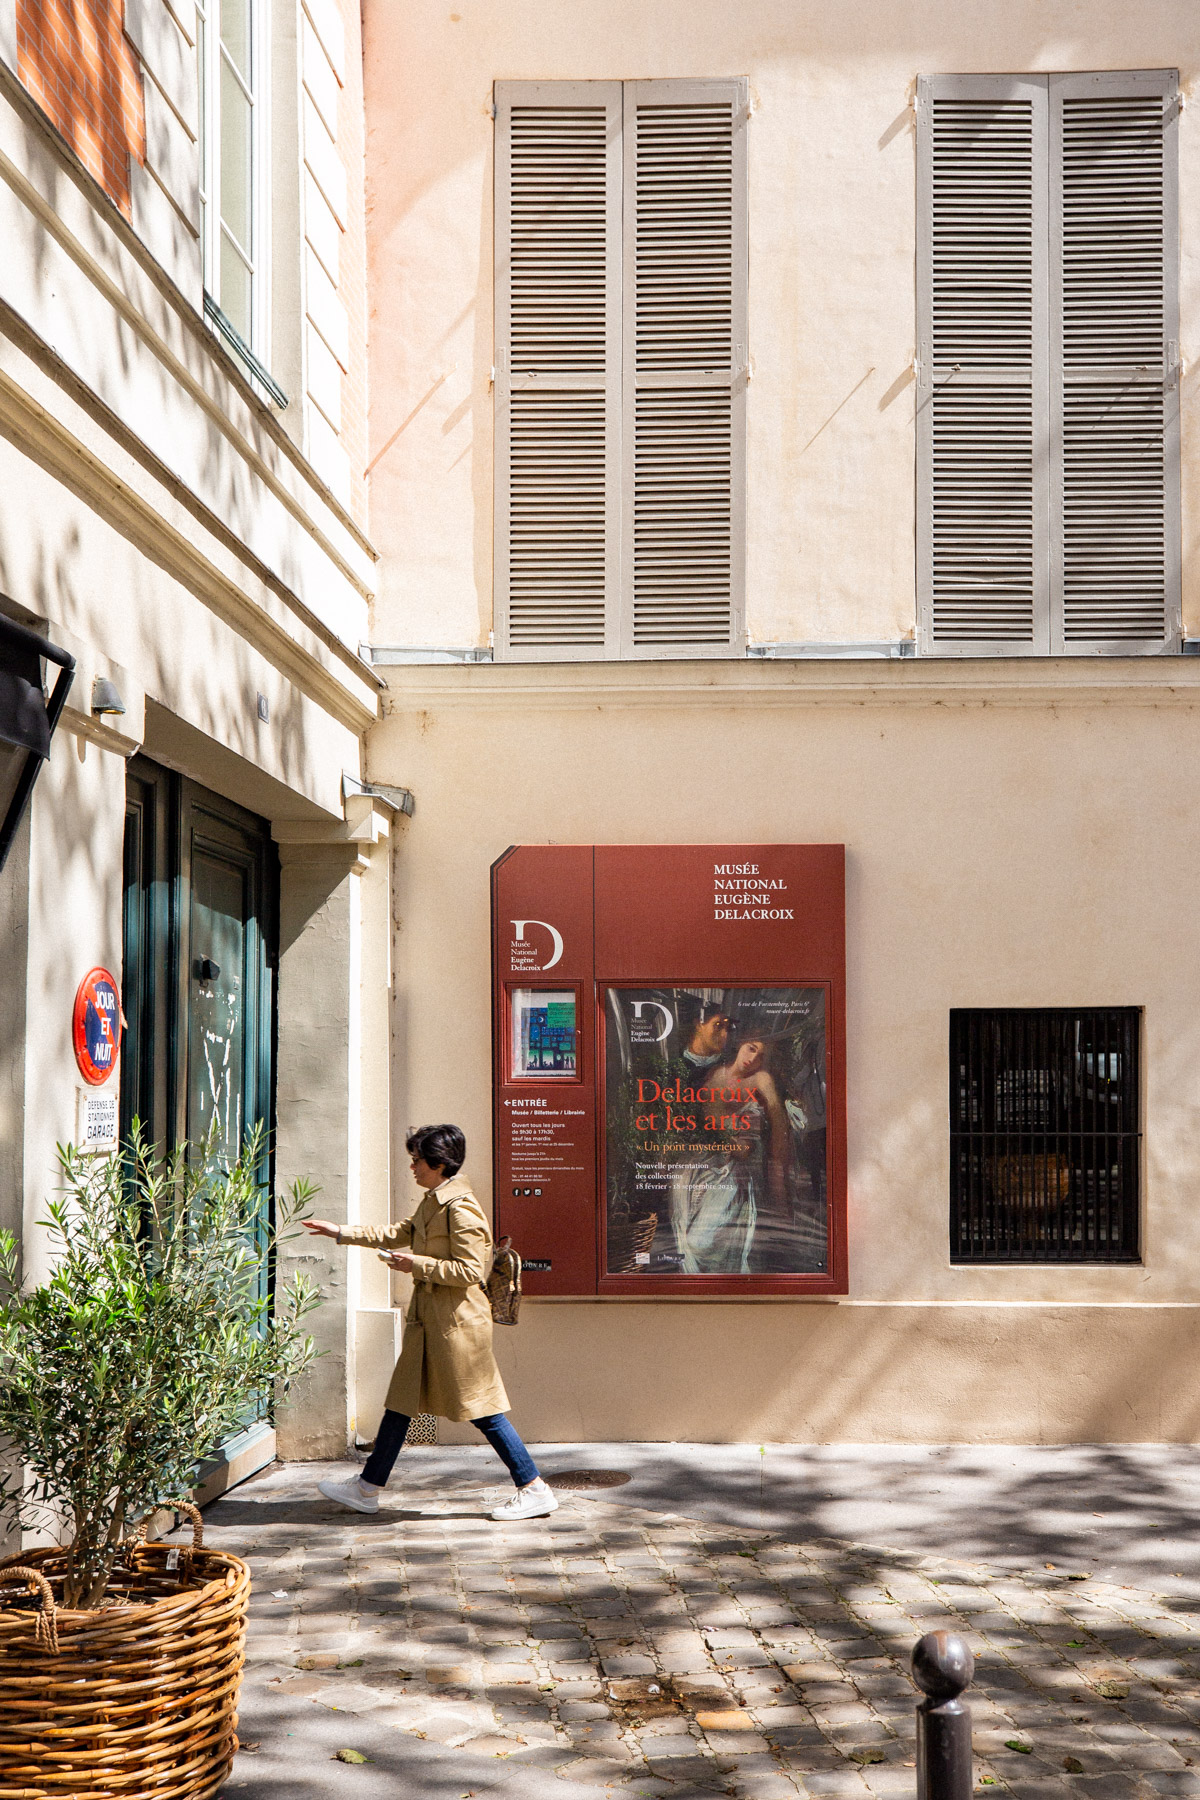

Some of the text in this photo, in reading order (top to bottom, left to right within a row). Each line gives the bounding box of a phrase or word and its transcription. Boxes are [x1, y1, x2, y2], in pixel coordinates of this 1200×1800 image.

[713, 861, 760, 875] MUSÉE
[713, 879, 788, 890] NATIONAL
[713, 891, 771, 905] EUGÈNE
[713, 909, 794, 920] DELACROIX
[511, 956, 535, 964] Eugène
[95, 990, 115, 1010] JOUR
[101, 1017, 111, 1035] ET
[94, 1042, 113, 1061] NUIT
[635, 1078, 759, 1103] Delacroix
[109, 1100, 115, 1109] DE
[511, 1098, 547, 1107] ENTRÉE
[88, 1112, 115, 1121] STATIONNER
[635, 1105, 751, 1131] et les arts
[87, 1124, 114, 1139] GARAGE
[644, 1141, 660, 1151] Un
[662, 1143, 686, 1154] pont
[688, 1141, 742, 1154] mystérieux
[667, 1162, 709, 1171] présentation
[682, 1183, 717, 1191] septembre
